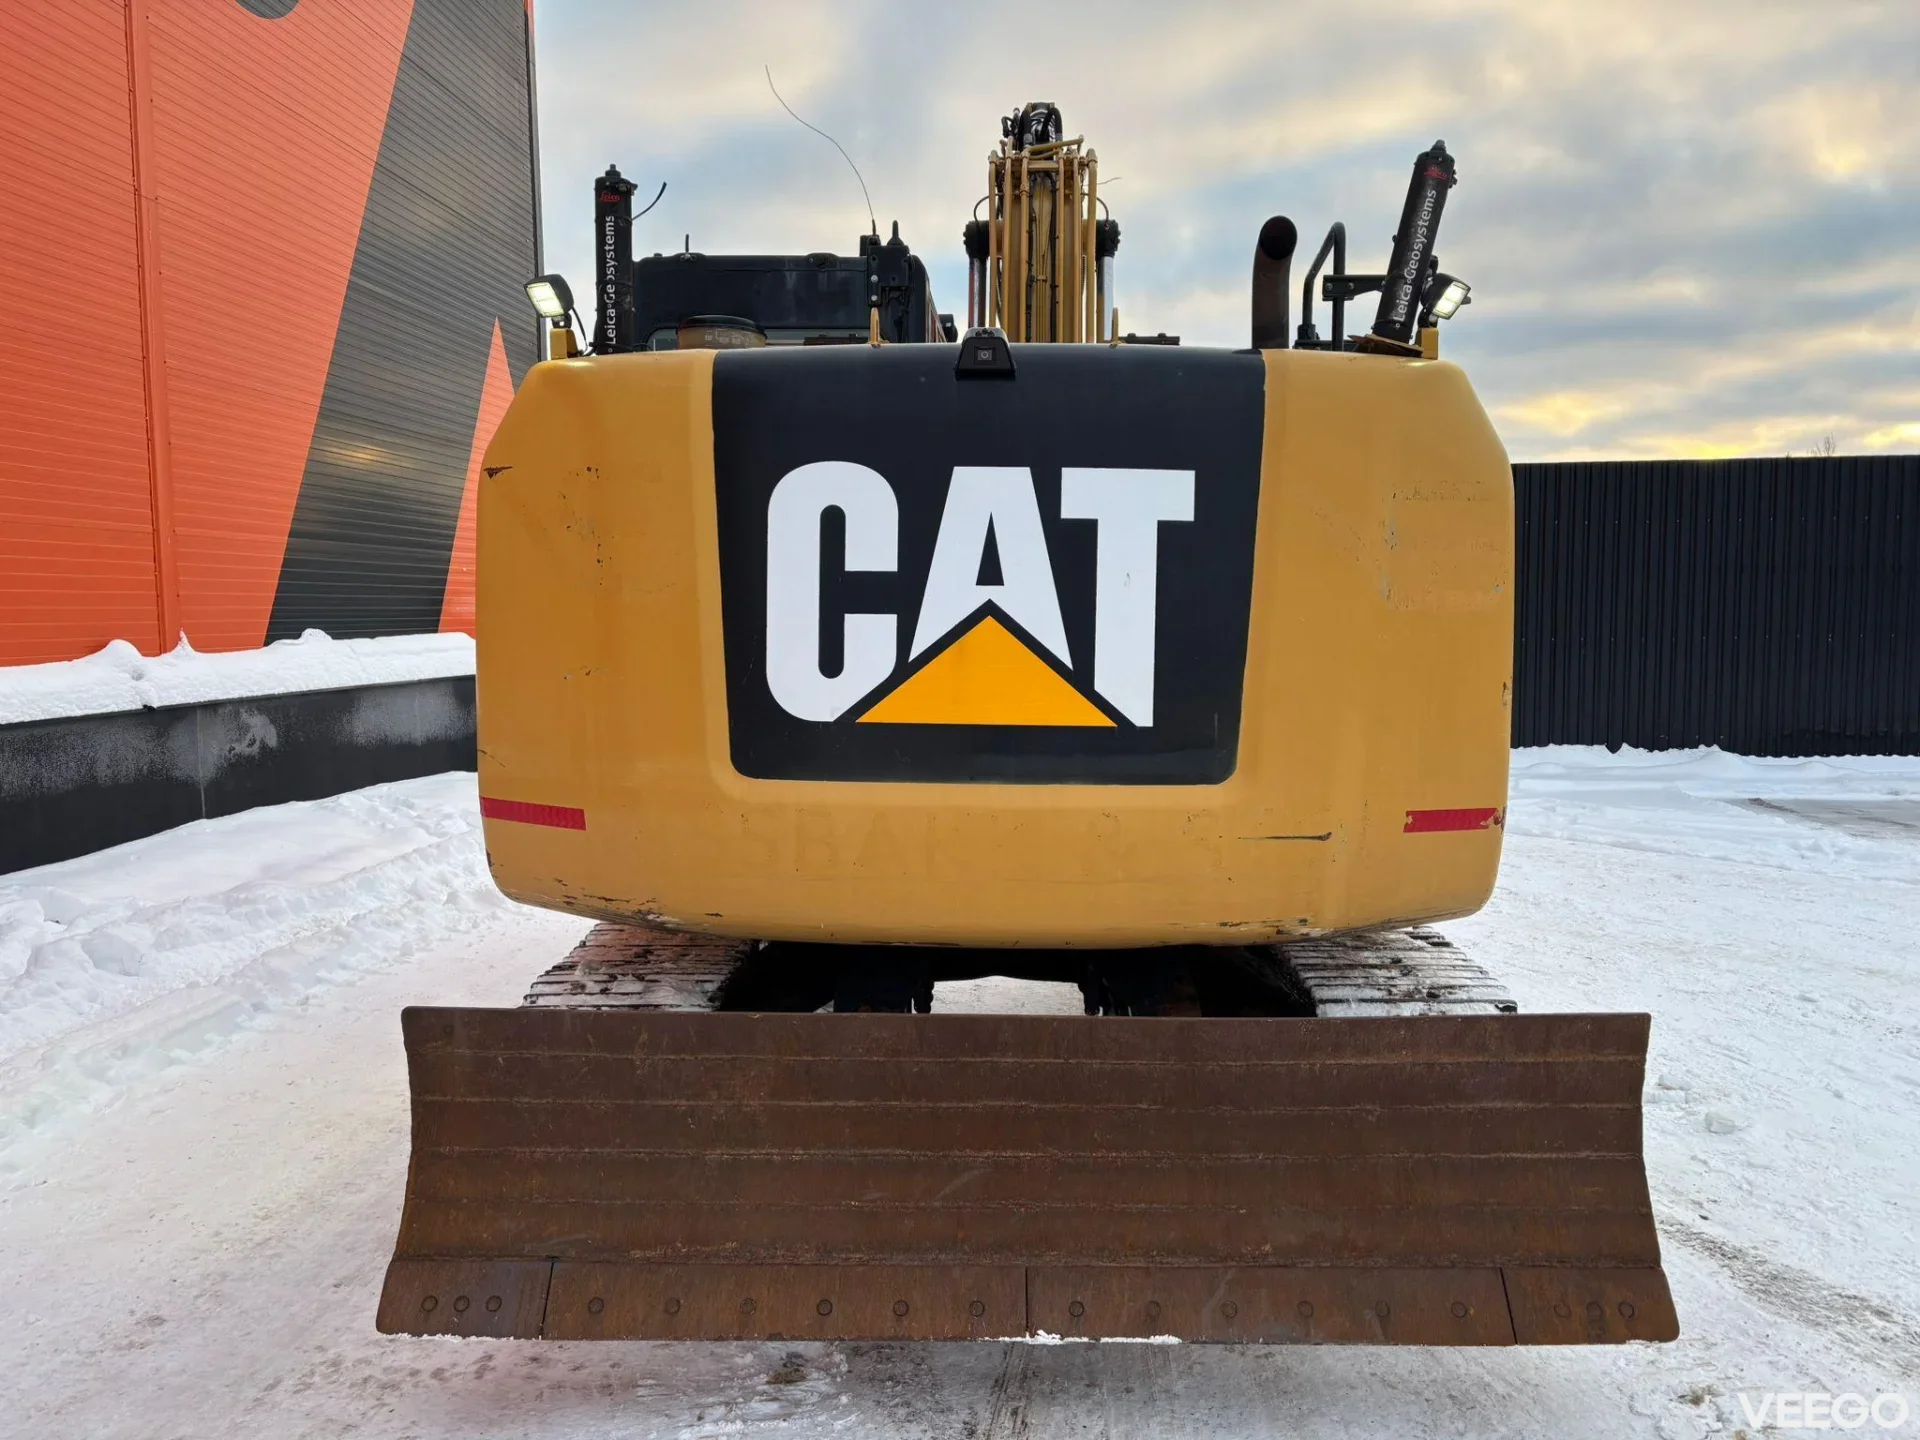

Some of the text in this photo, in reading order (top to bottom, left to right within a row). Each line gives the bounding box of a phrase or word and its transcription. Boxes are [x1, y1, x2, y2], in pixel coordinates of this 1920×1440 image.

[1393, 285, 1413, 322] Leica
[1404, 189, 1437, 279] Geosystems
[604, 309, 617, 345] Leica
[766, 461, 1195, 727] CAT
